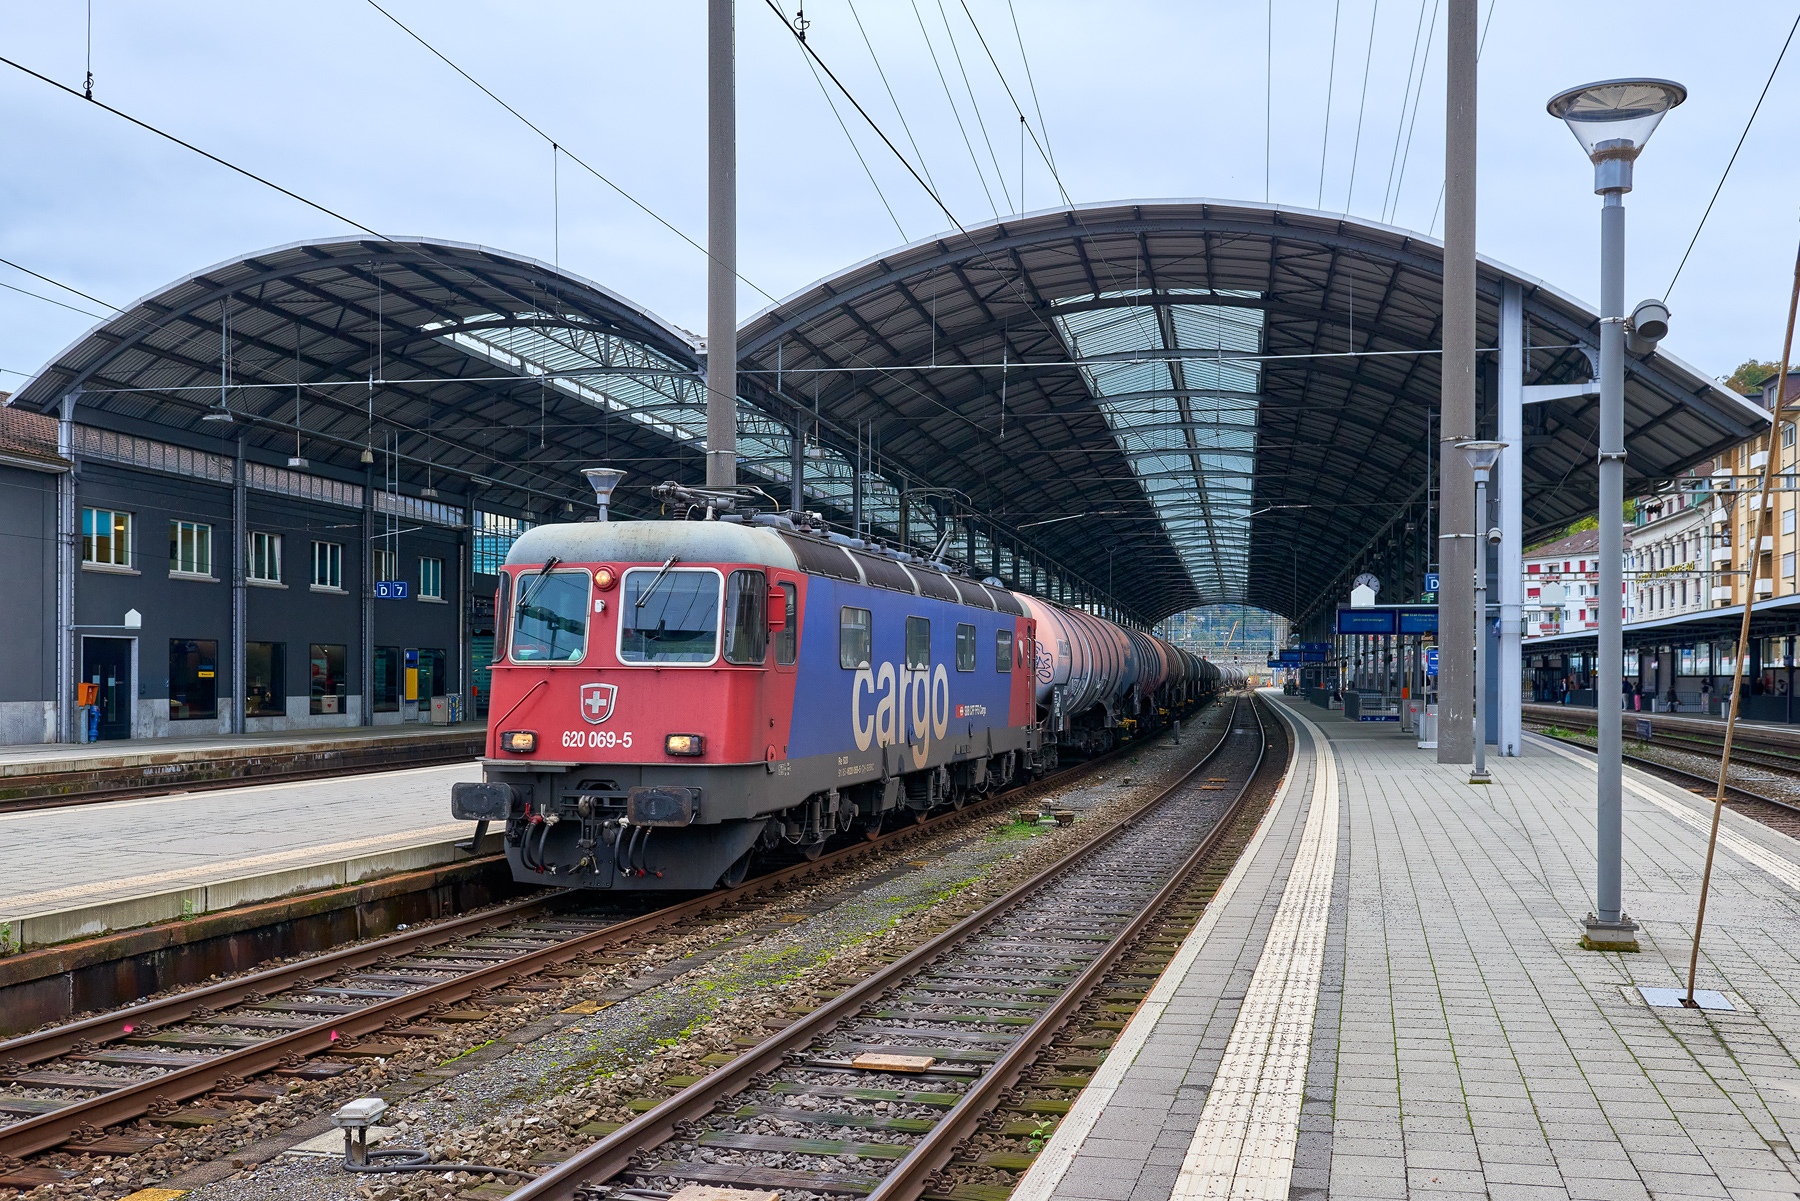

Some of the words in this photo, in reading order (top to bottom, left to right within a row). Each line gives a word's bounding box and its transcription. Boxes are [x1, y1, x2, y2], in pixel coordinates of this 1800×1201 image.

[1431, 579, 1440, 589] D
[380, 587, 388, 596] D
[396, 587, 403, 596] 7
[852, 660, 949, 769] cargo
[562, 730, 586, 748] 620
[588, 731, 633, 748] 069-5
